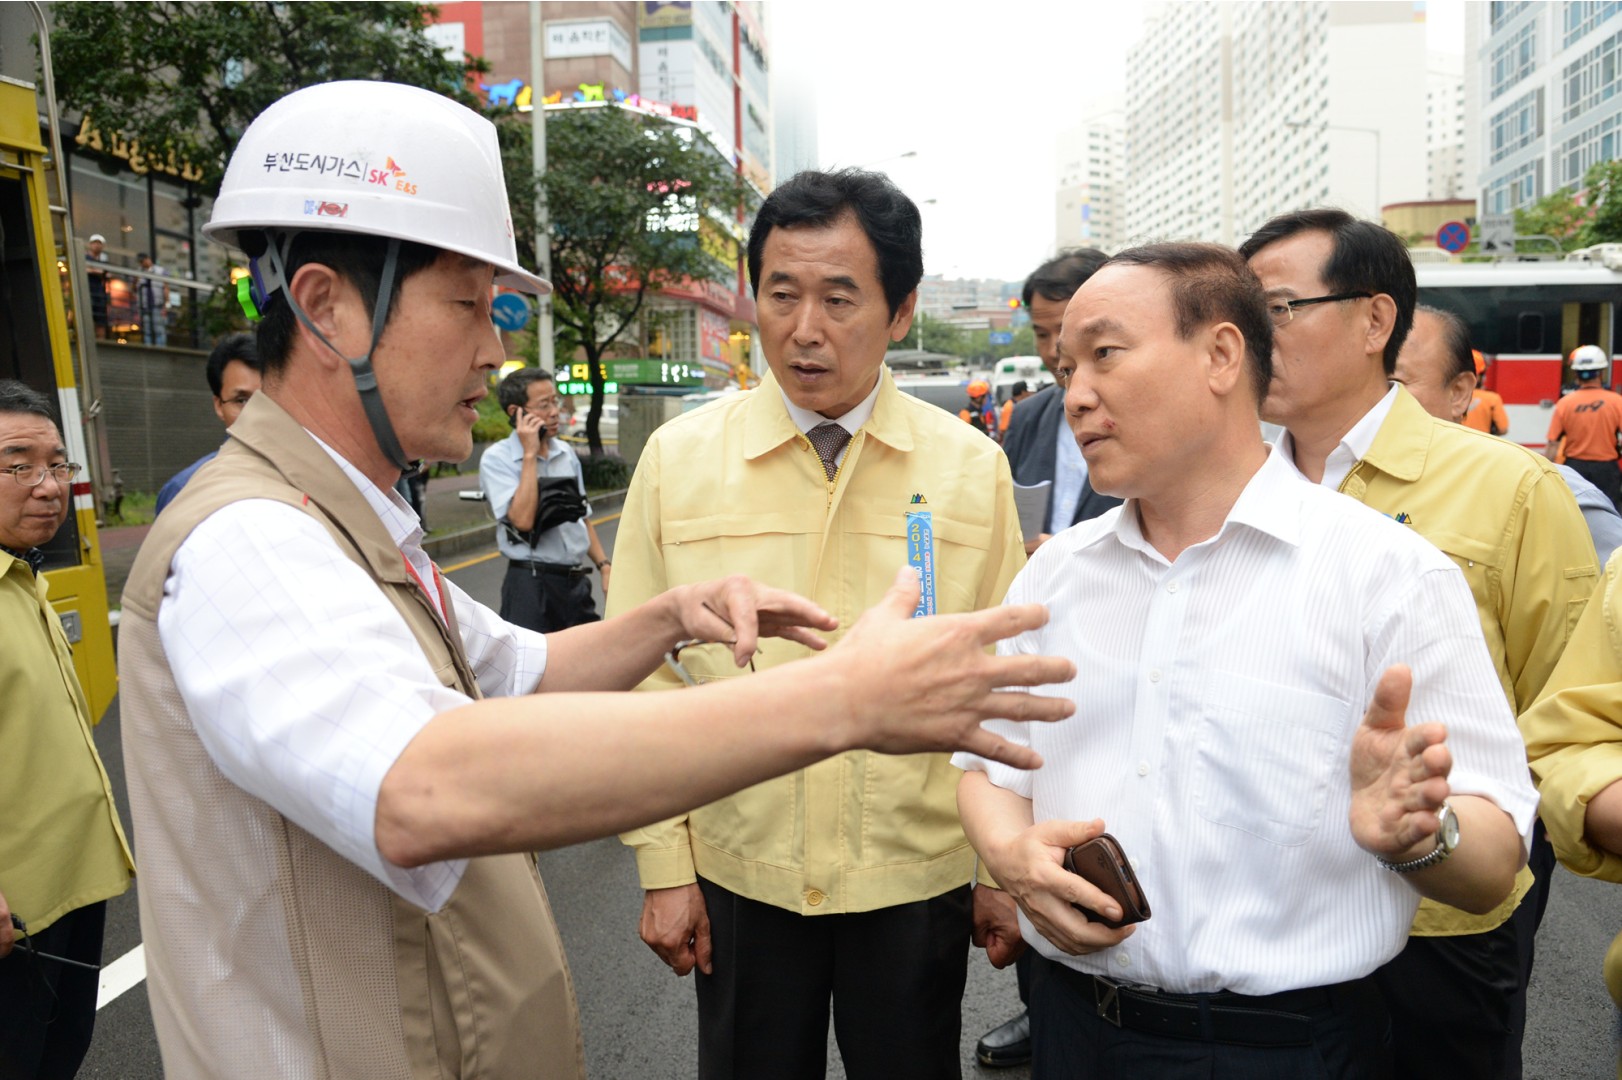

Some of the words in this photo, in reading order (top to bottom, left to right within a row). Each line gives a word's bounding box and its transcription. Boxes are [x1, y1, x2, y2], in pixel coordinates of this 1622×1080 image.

[263, 152, 361, 179] 부산도시가스
[368, 168, 390, 187] SK
[395, 179, 418, 196] E&S
[911, 523, 922, 562] 2014
